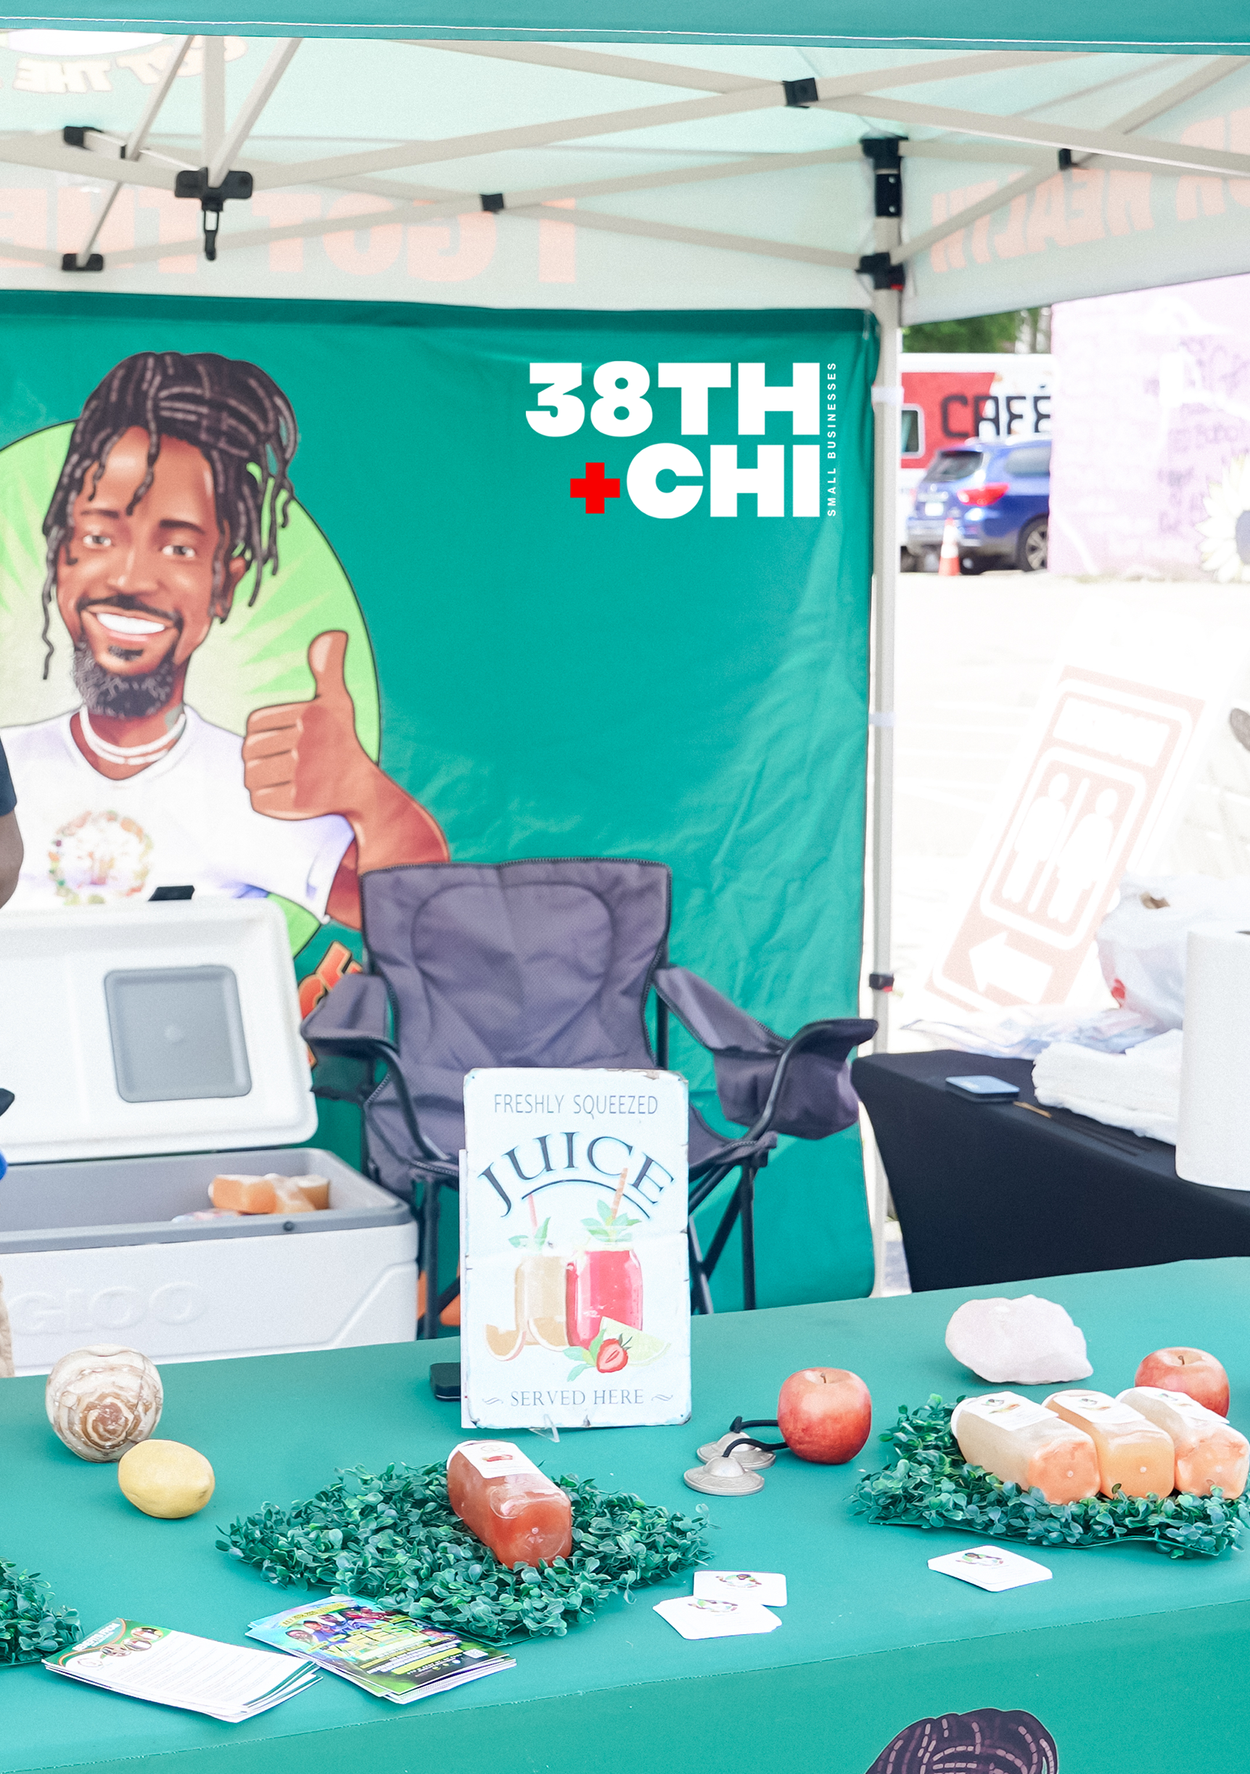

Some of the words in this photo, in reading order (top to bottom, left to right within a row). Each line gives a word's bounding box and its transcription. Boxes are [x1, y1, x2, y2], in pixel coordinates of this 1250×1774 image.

[493, 1093, 565, 1115] FRESHLY
[572, 1094, 659, 1120] SQUEEZED
[478, 1131, 675, 1217] JUICE
[510, 1389, 586, 1407] SERVED
[593, 1389, 644, 1405] HERE
